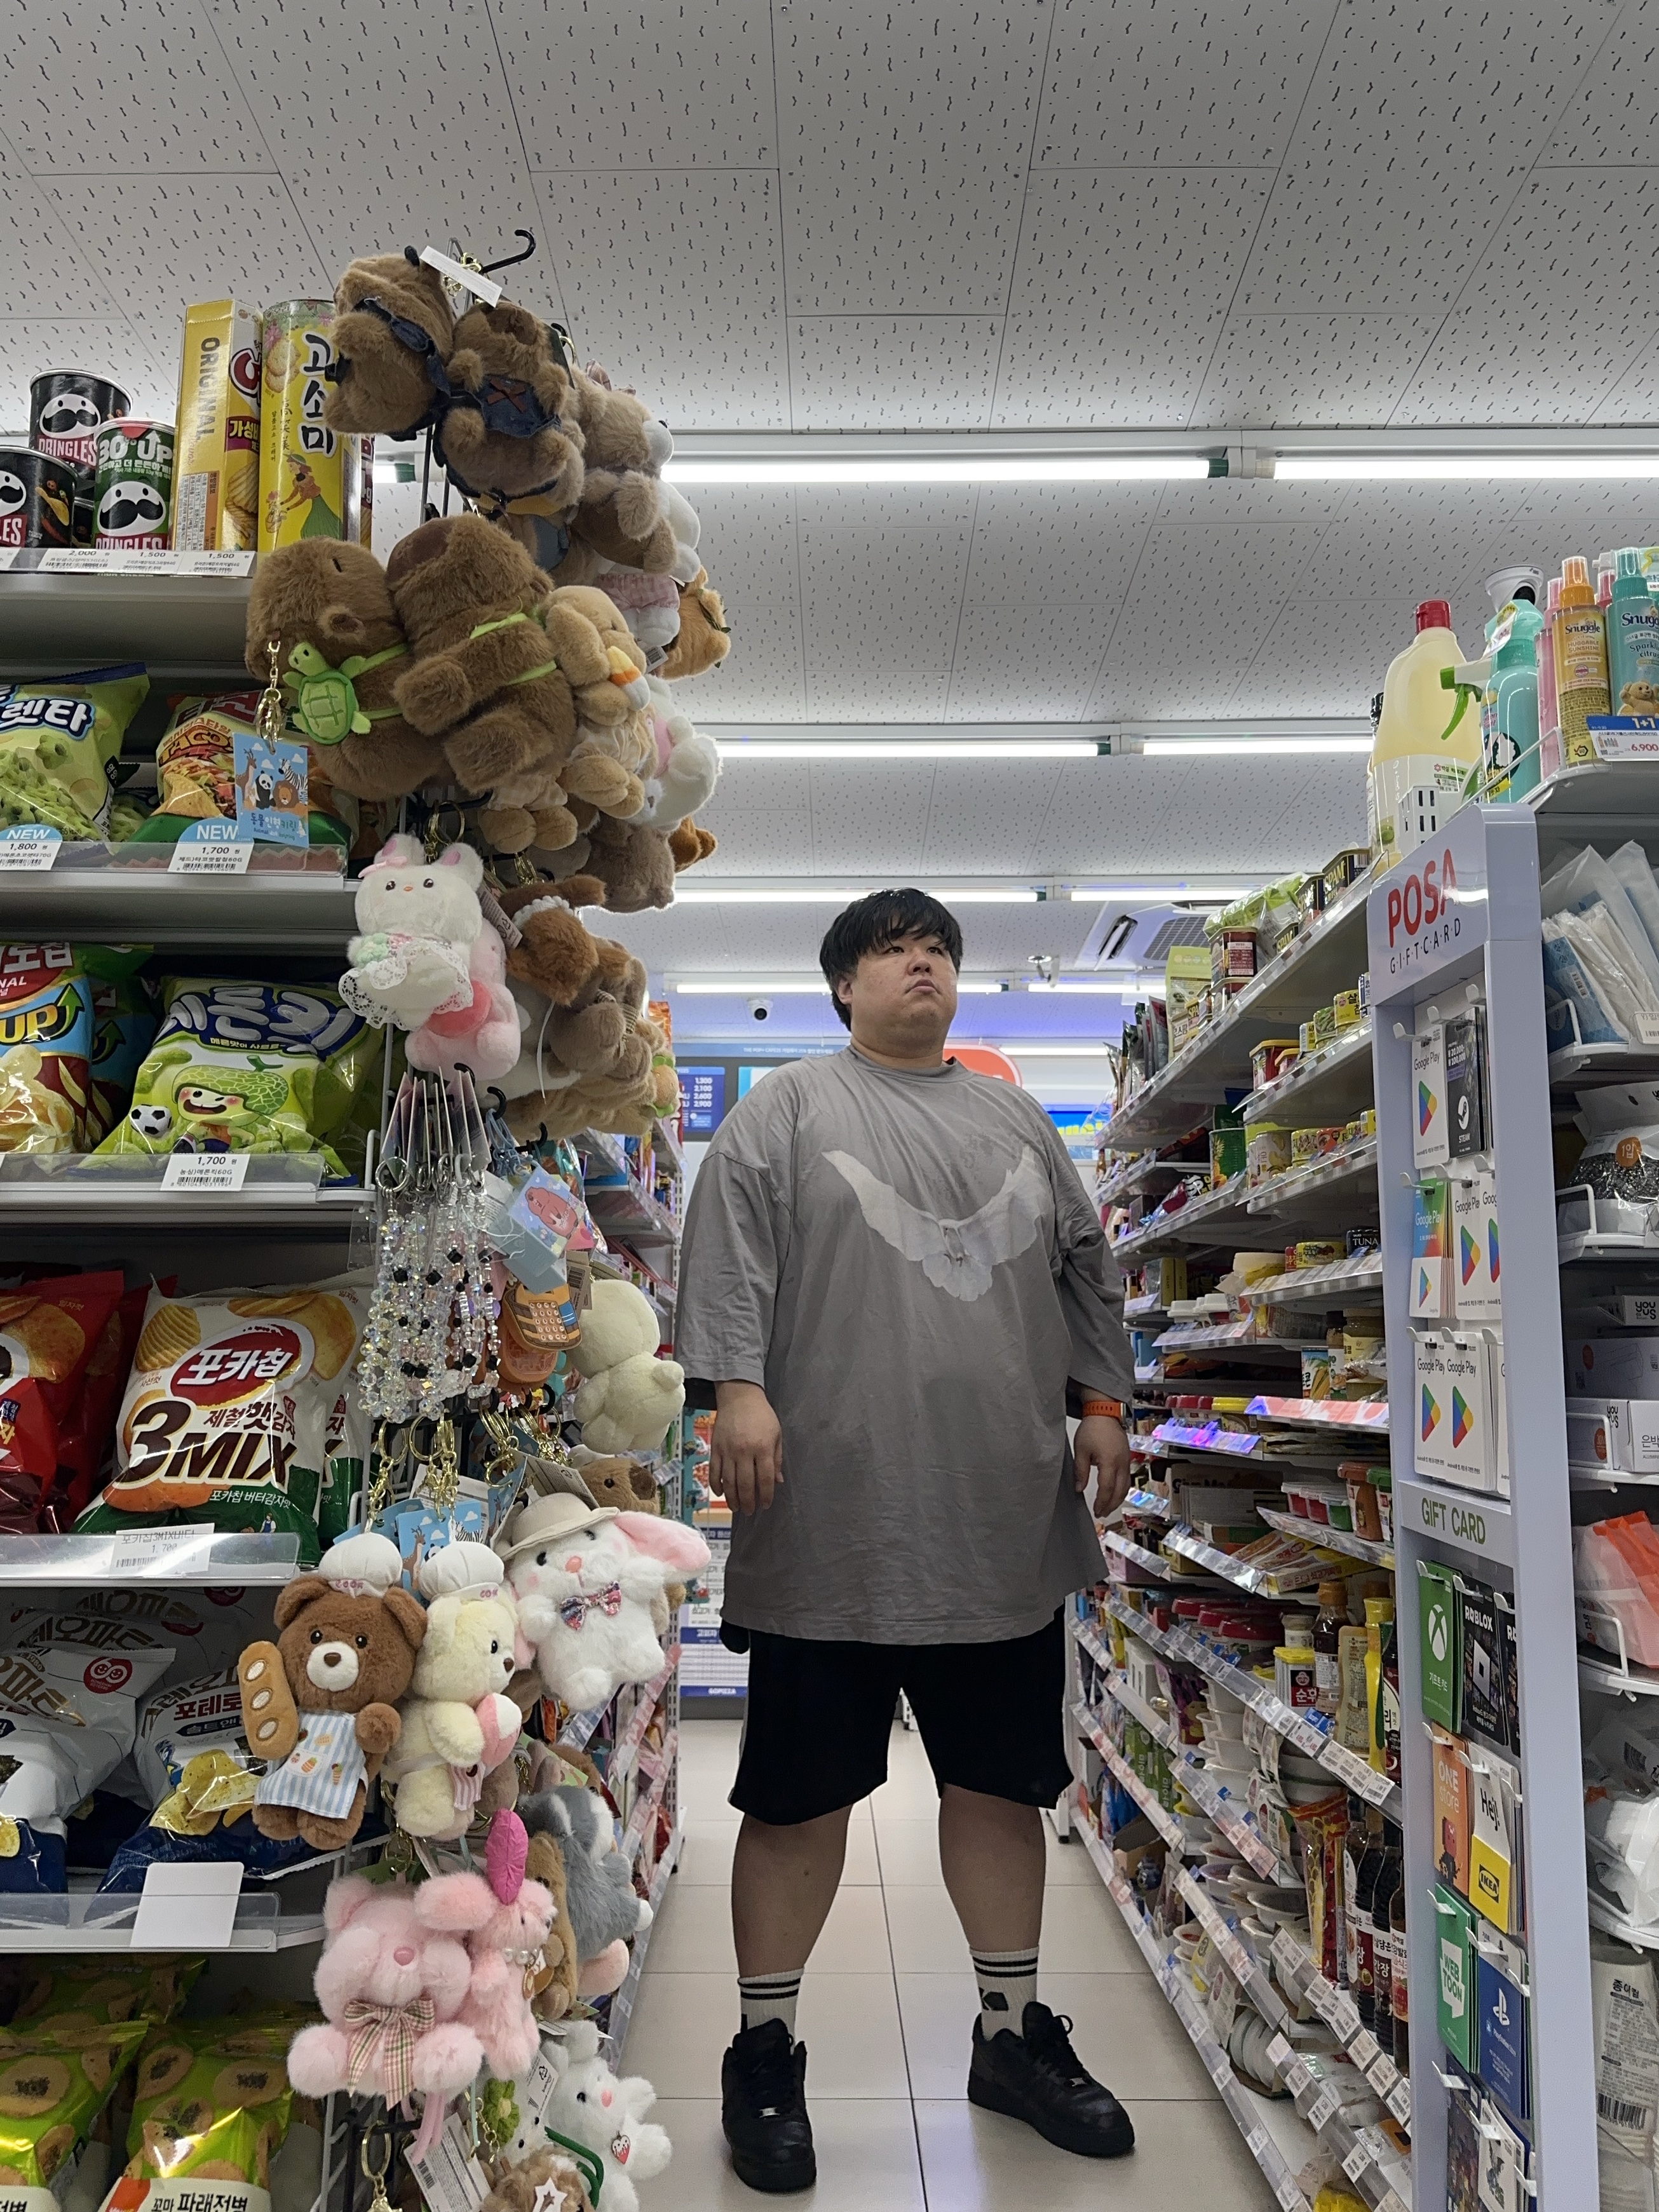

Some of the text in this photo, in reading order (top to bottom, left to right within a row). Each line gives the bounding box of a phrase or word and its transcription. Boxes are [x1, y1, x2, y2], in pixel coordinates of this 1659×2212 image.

[196, 337, 220, 438] ORIGINAL
[302, 332, 336, 456] 고소미
[137, 430, 173, 463] UP
[0, 517, 23, 546] ES
[1565, 621, 1601, 635] Snuggle
[1568, 640, 1600, 648] HUGGABLE
[1632, 717, 1656, 729] 1+1
[1631, 743, 1659, 752] 6,900
[6, 830, 51, 840] NEW
[196, 825, 238, 840] NEW
[10, 843, 37, 851] 1,800
[1324, 861, 1346, 891] SPAM
[1388, 849, 1458, 948] POSA
[1276, 930, 1294, 953] SPAM
[1188, 1003, 1200, 1019] SPA
[1414, 1051, 1440, 1071] Google Play
[1458, 1133, 1471, 1144] STEAM
[198, 1156, 226, 1166] 1,700
[1454, 1199, 1472, 1215] Google
[1415, 1210, 1442, 1229] Google Play
[1352, 1238, 1379, 1246] TUNA
[177, 1347, 294, 1386] 포카칩
[1417, 1358, 1446, 1375] Google Play
[1447, 1358, 1477, 1378] Google Play
[204, 1406, 244, 1429] 제철
[210, 1490, 292, 1509] 포카칩 버터감자맛
[1421, 1496, 1486, 1546] GIFT CARD
[1465, 1605, 1493, 1632] ROBLOX
[1295, 1687, 1318, 1703] 순후
[1439, 1760, 1459, 1794] ONE
[1439, 1786, 1460, 1814] store
[1480, 1786, 1501, 1831] Hej!
[1480, 1870, 1499, 1897] IKEA
[1444, 1953, 1460, 1983] WEB
[1442, 1967, 1463, 2003] TOON
[1613, 1978, 1639, 1999] 종이컵
[152, 2192, 248, 2212] 꼬마 파래전병
